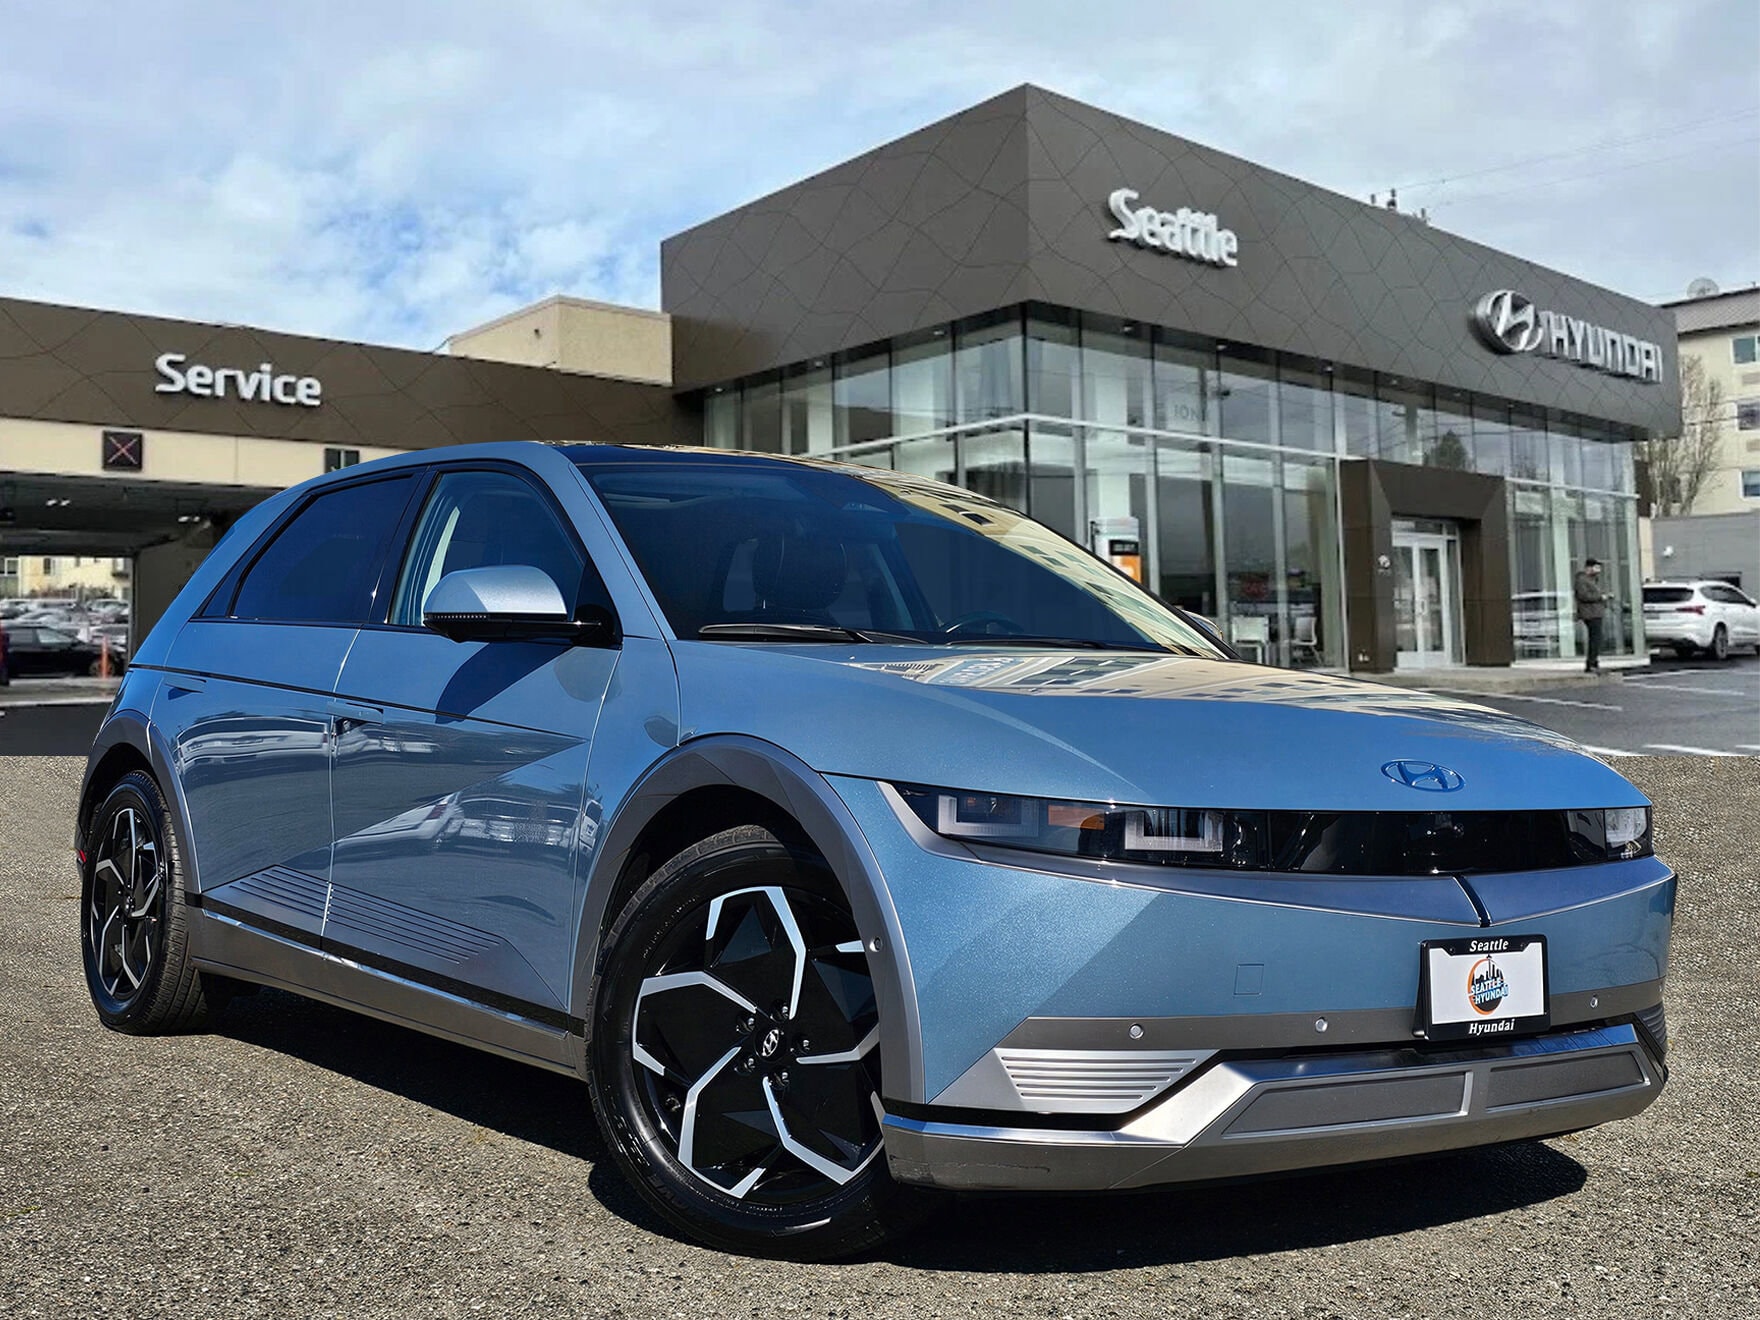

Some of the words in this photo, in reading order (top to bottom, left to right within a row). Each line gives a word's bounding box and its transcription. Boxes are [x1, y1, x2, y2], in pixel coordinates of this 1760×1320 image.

[1108, 187, 1238, 267] Seattle
[1540, 310, 1664, 384] HYUNDAI
[155, 352, 322, 407] Service
[1469, 938, 1510, 953] Seattle
[1470, 978, 1503, 995] SEATTLE
[1475, 984, 1510, 1005] HYUNDAI
[1468, 1018, 1516, 1036] Hyundai
